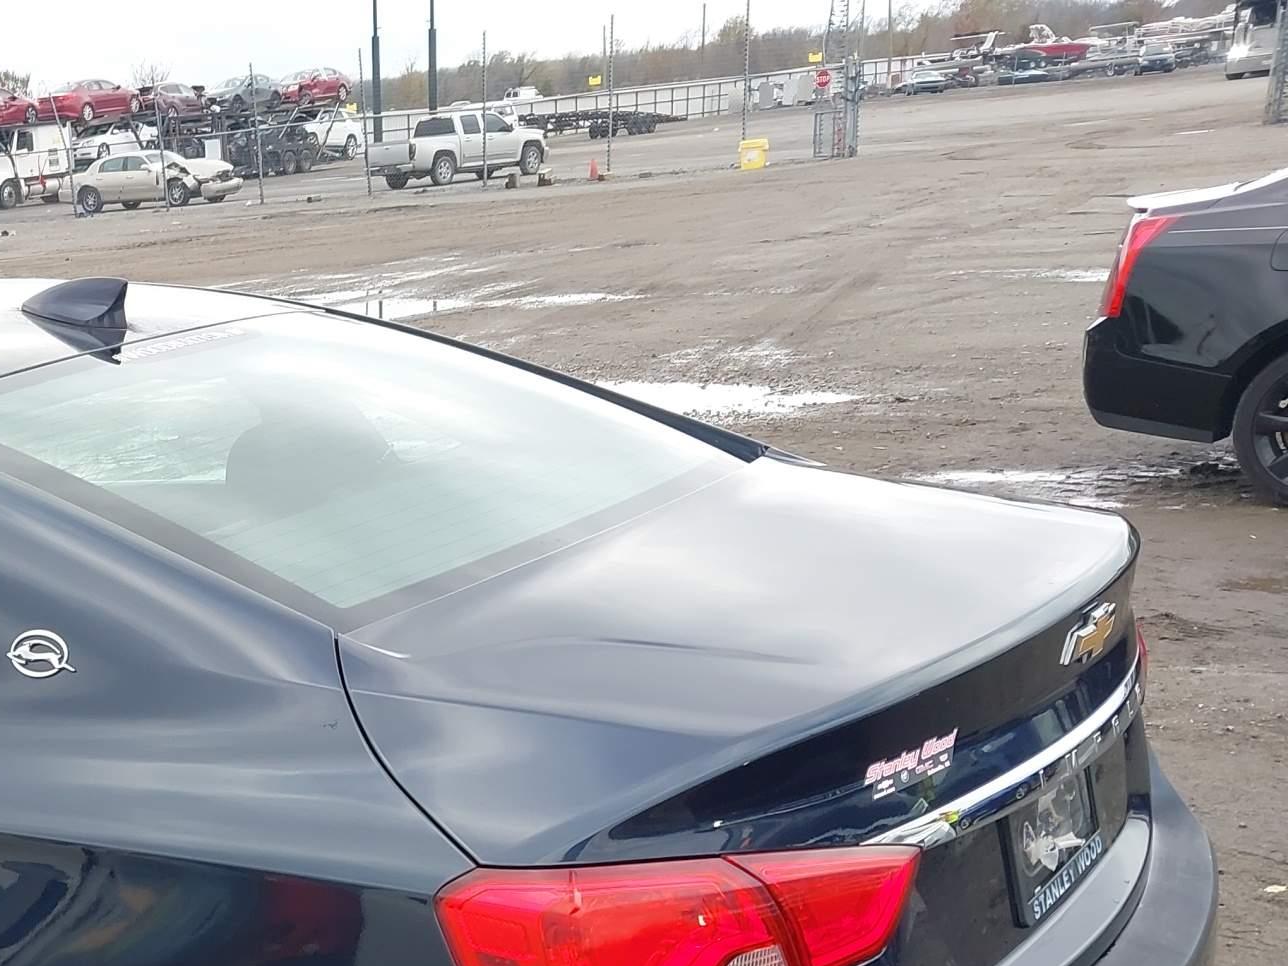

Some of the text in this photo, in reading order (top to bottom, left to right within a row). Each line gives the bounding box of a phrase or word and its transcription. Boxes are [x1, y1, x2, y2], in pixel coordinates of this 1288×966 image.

[863, 747, 921, 785] Stanley
[920, 727, 958, 760] Wood
[1033, 836, 1103, 920] STANLEY WOOD
